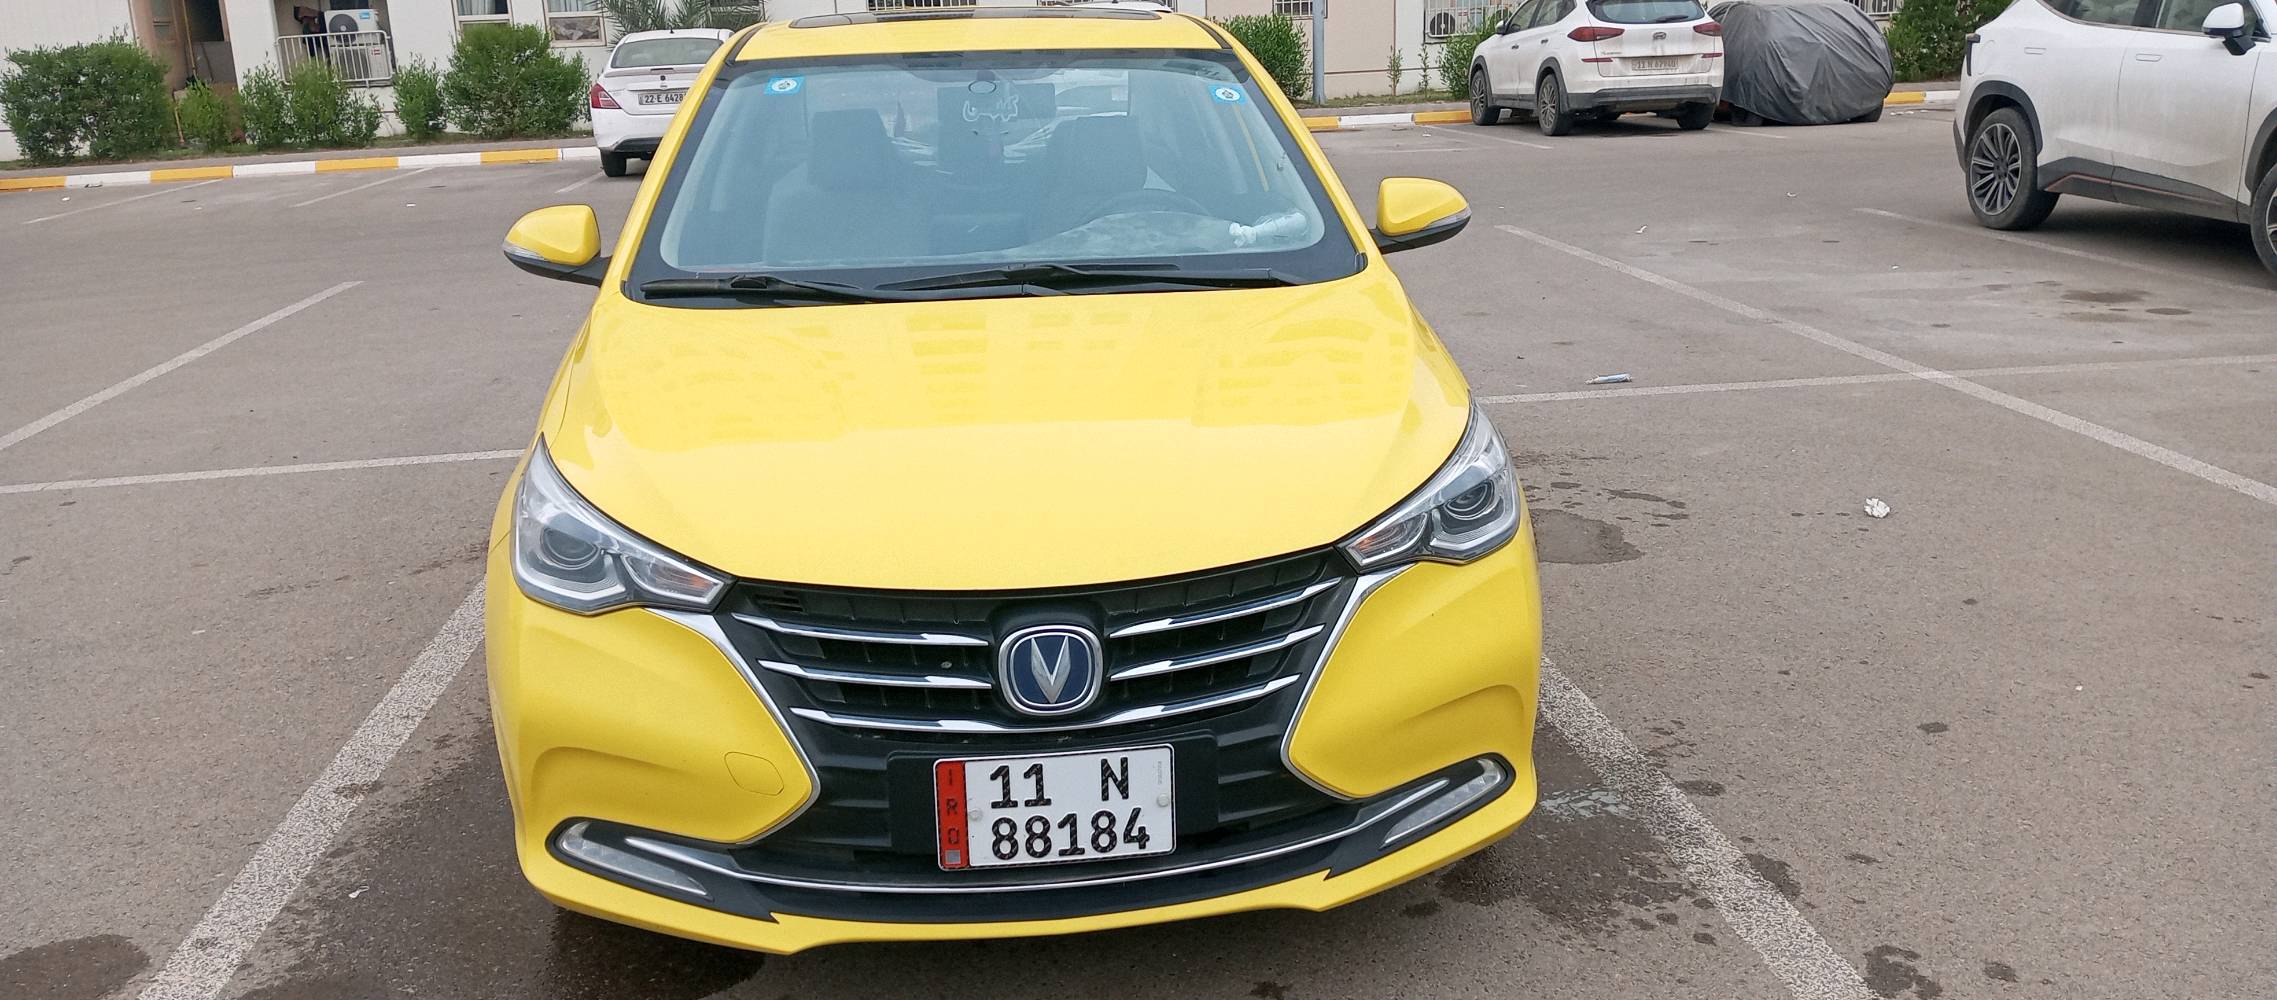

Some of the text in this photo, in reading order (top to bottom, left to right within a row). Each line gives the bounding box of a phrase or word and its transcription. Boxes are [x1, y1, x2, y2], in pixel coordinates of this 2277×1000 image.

[644, 93, 686, 103] 22 E 6428
[989, 763, 1052, 809] 11
[1100, 757, 1129, 801] N
[991, 807, 1150, 860] 88184
